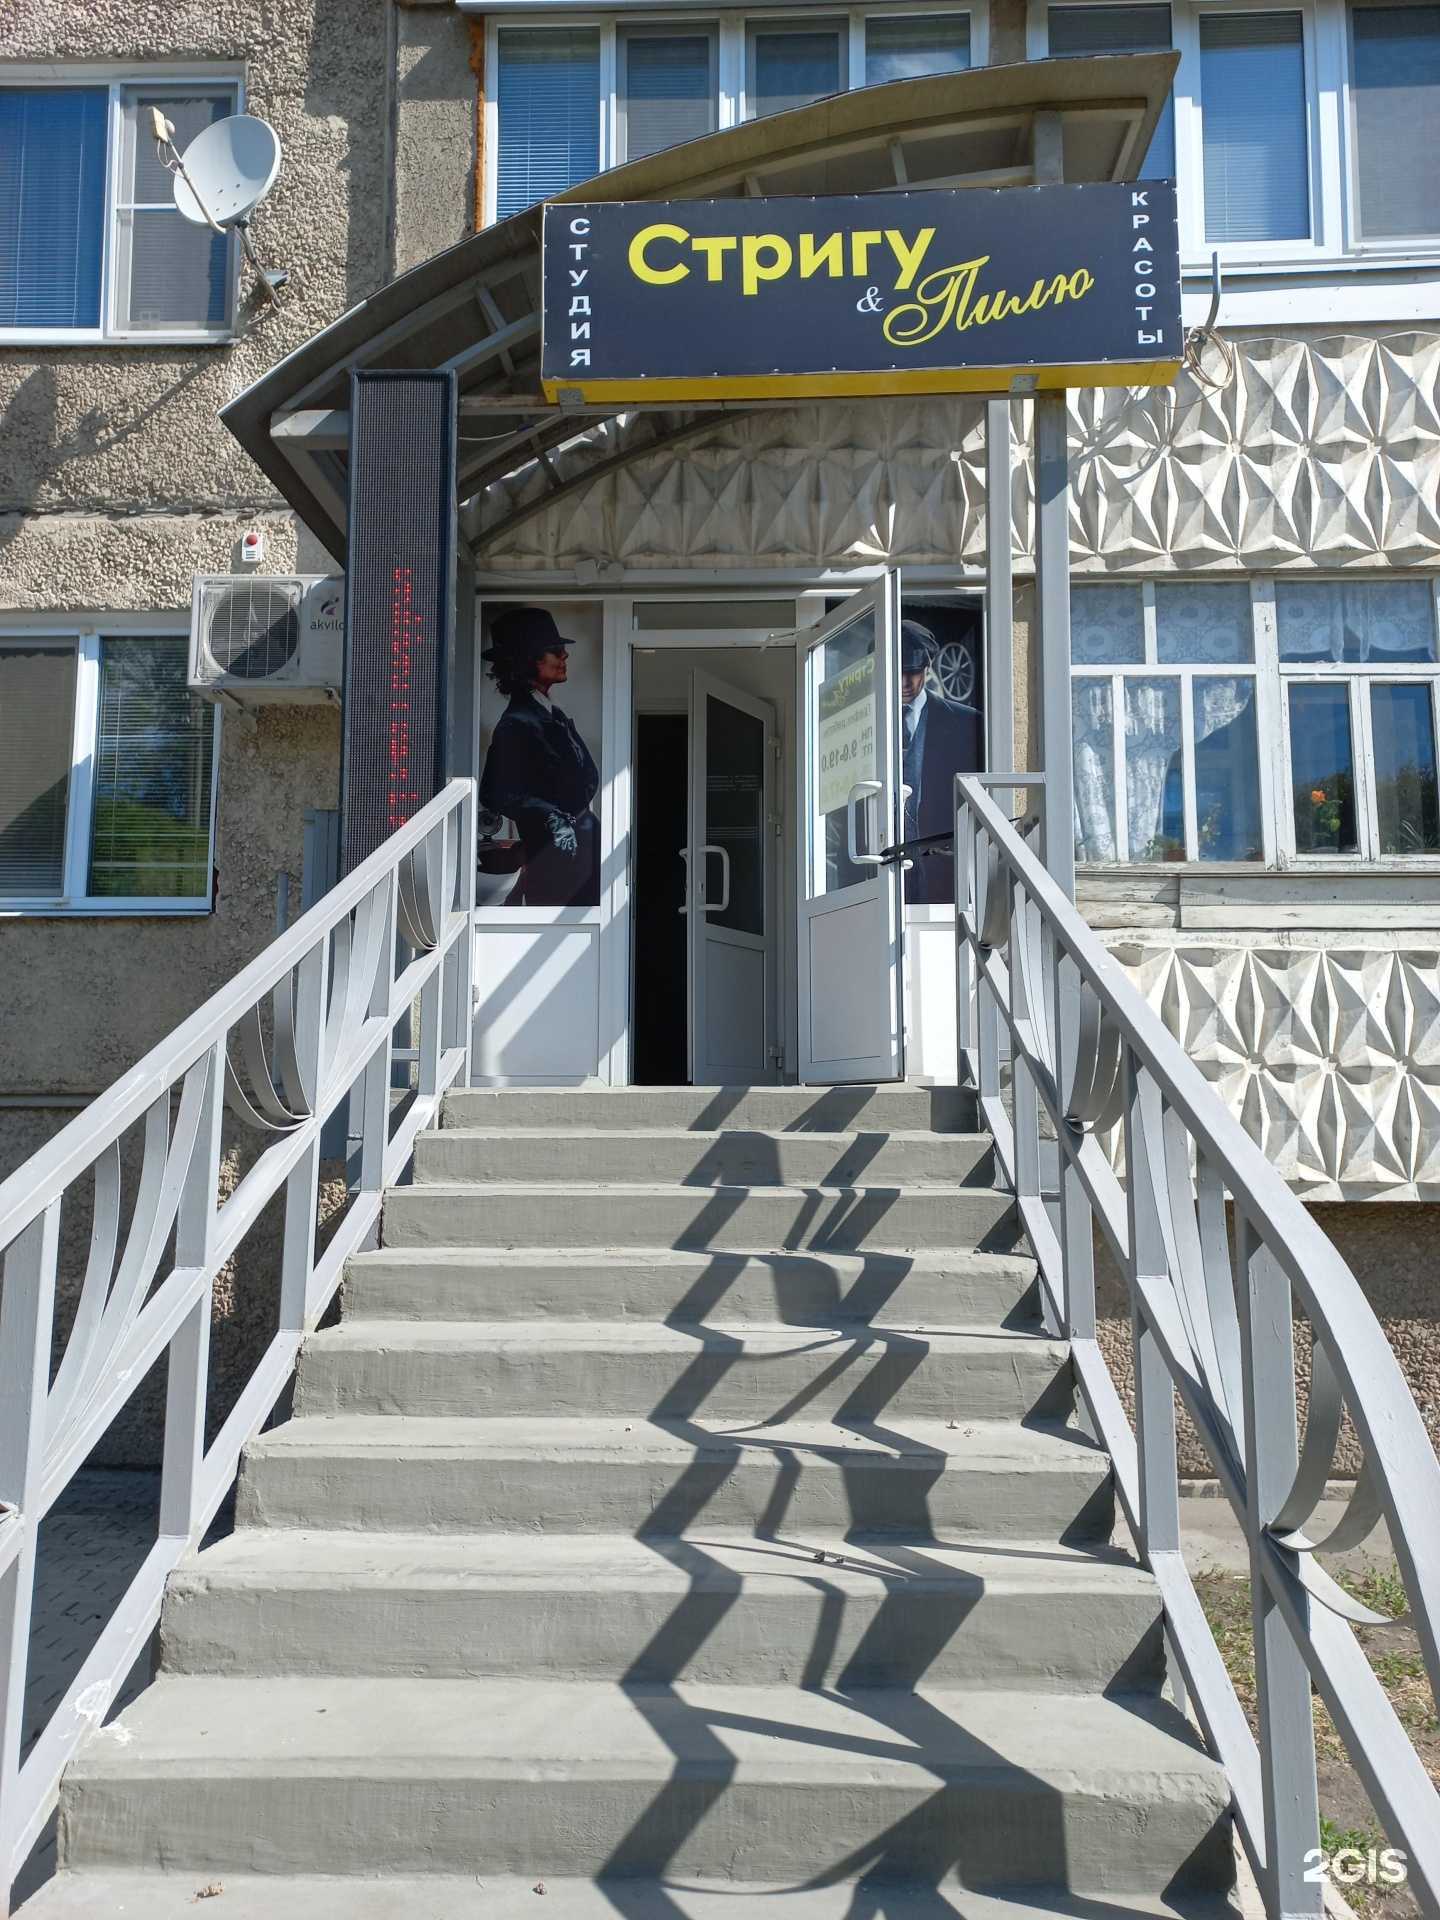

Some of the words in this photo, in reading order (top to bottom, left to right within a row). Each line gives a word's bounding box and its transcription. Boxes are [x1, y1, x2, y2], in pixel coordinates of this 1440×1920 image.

[568, 217, 592, 367] СТУДИЯ
[628, 224, 936, 295] Стригу
[856, 287, 884, 313] &
[882, 255, 1094, 347] Пилю
[1131, 191, 1164, 345] КРАСОТЫ
